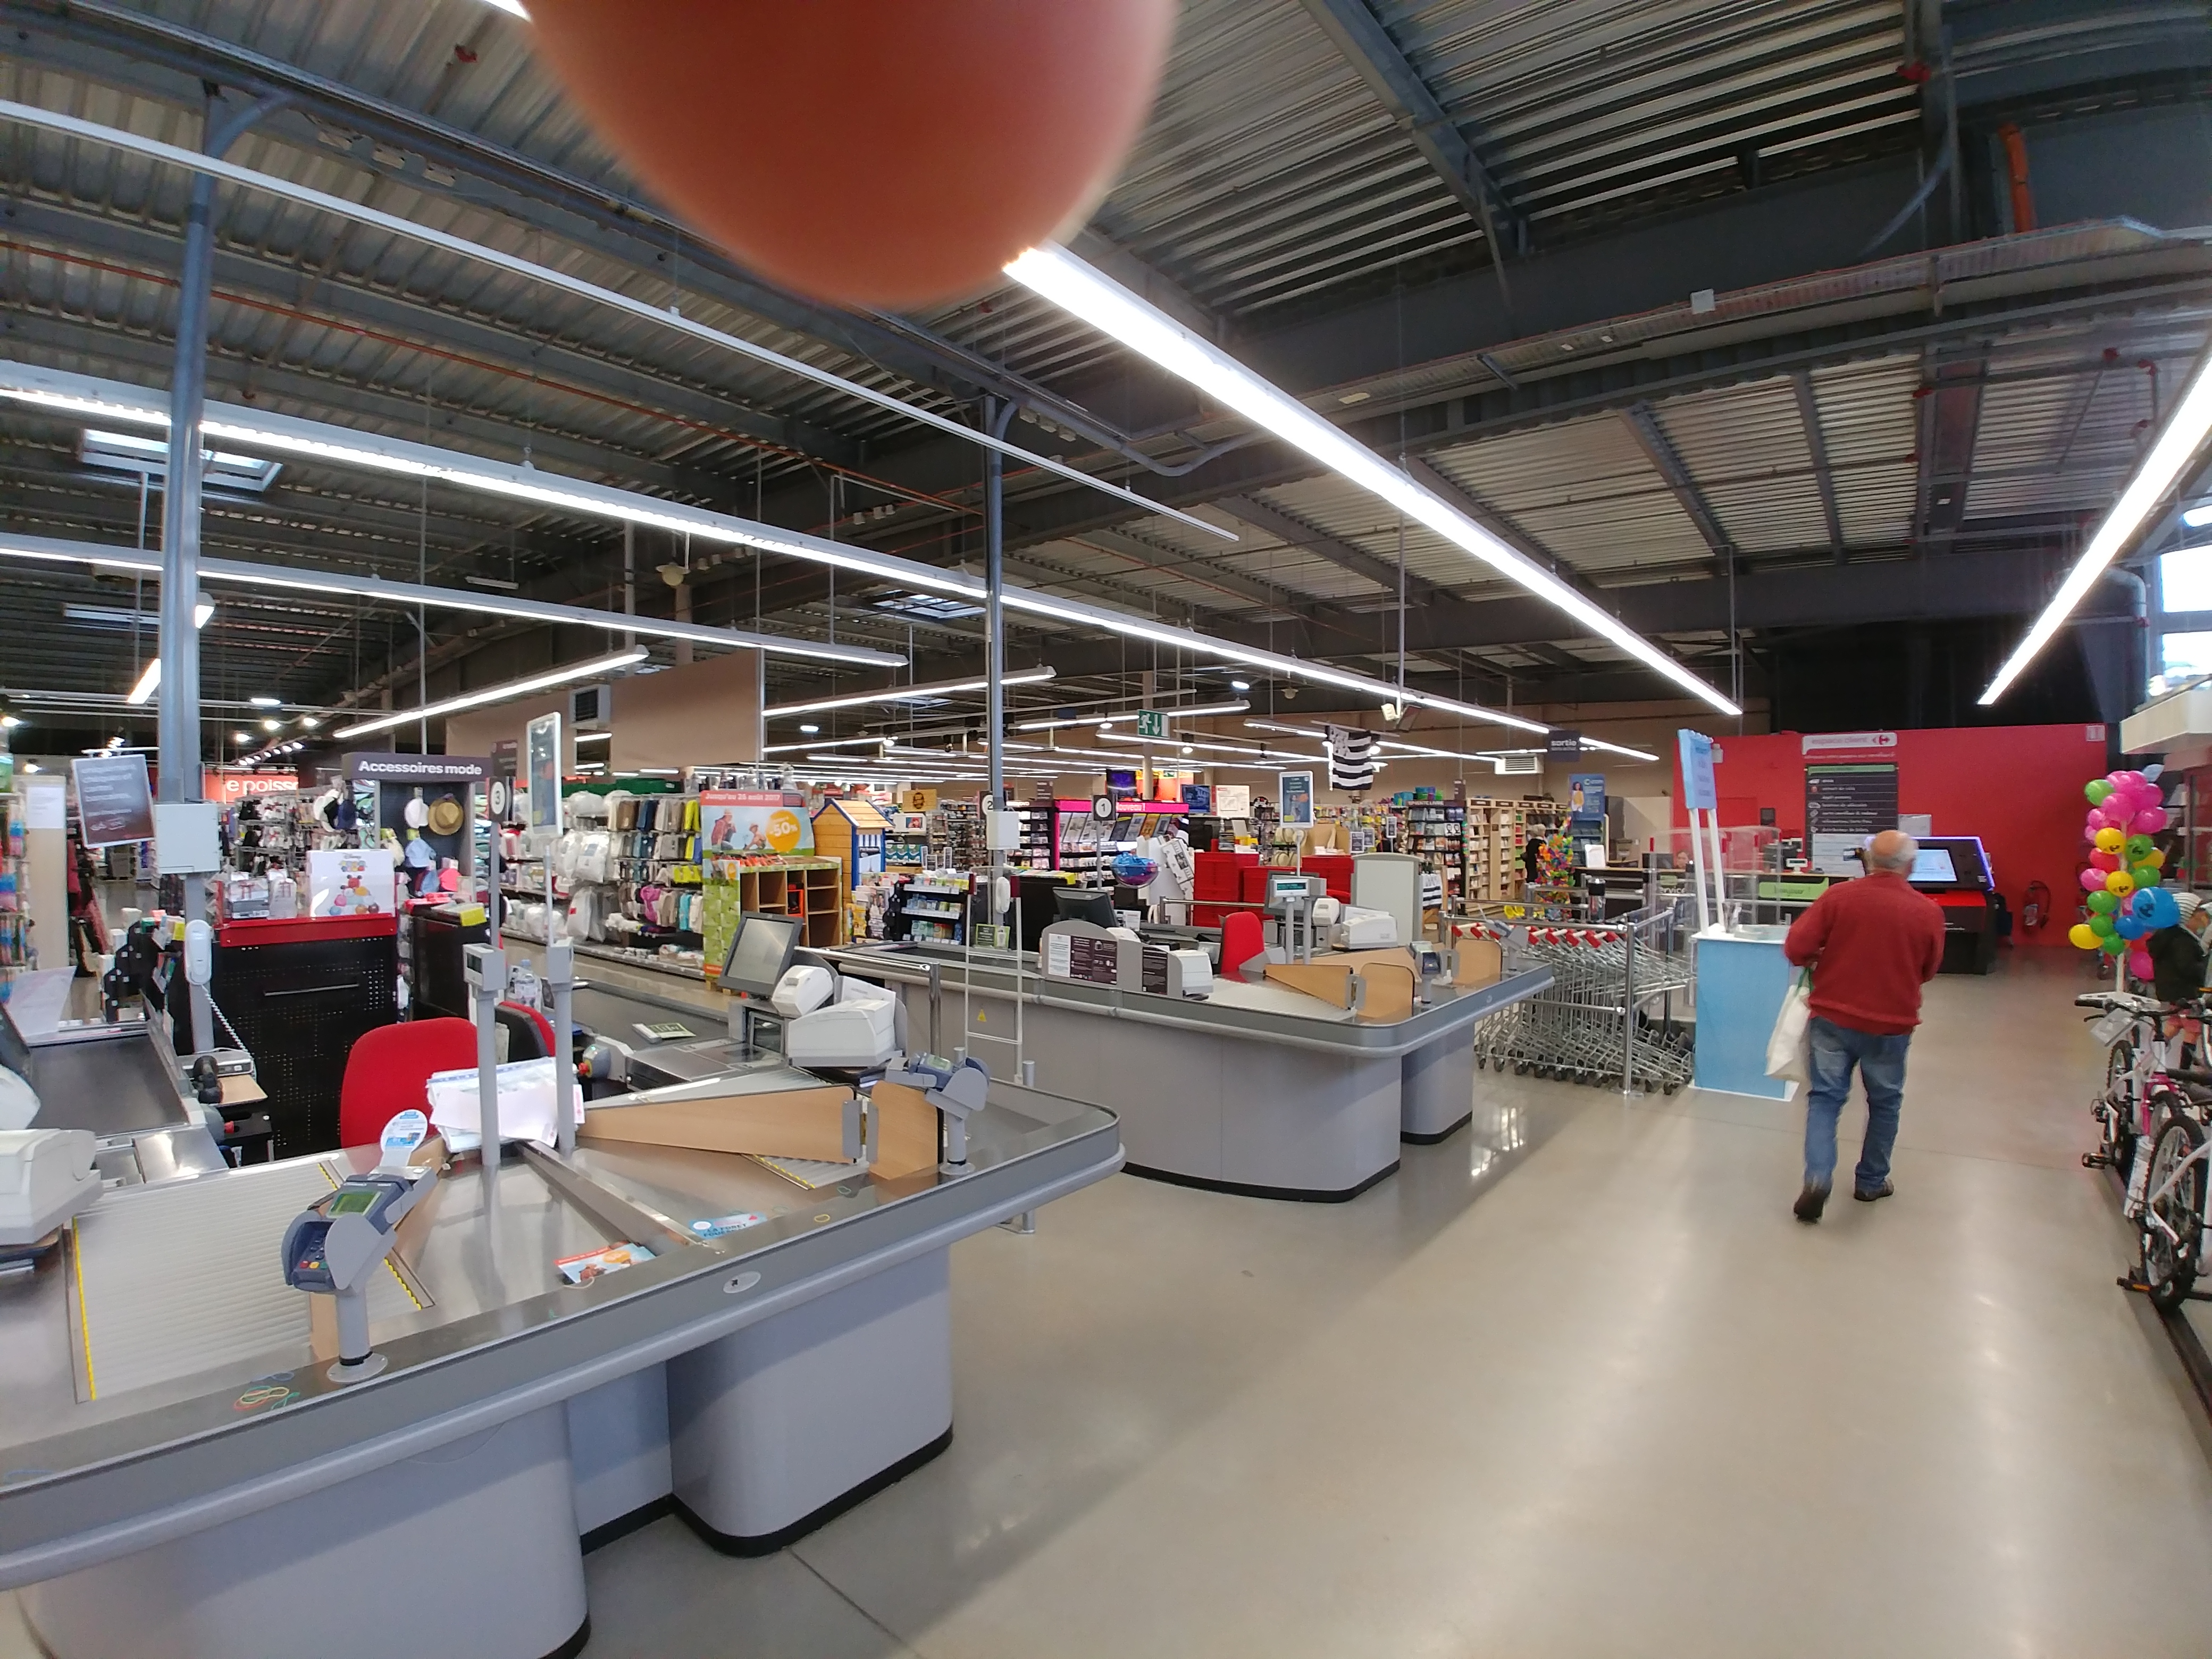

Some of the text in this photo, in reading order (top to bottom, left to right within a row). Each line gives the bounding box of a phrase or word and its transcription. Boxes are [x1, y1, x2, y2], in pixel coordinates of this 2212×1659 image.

[358, 760, 482, 775] Accessoires mode
[495, 790, 501, 805] 3
[987, 800, 993, 810] 2
[1101, 803, 1105, 812] 1
